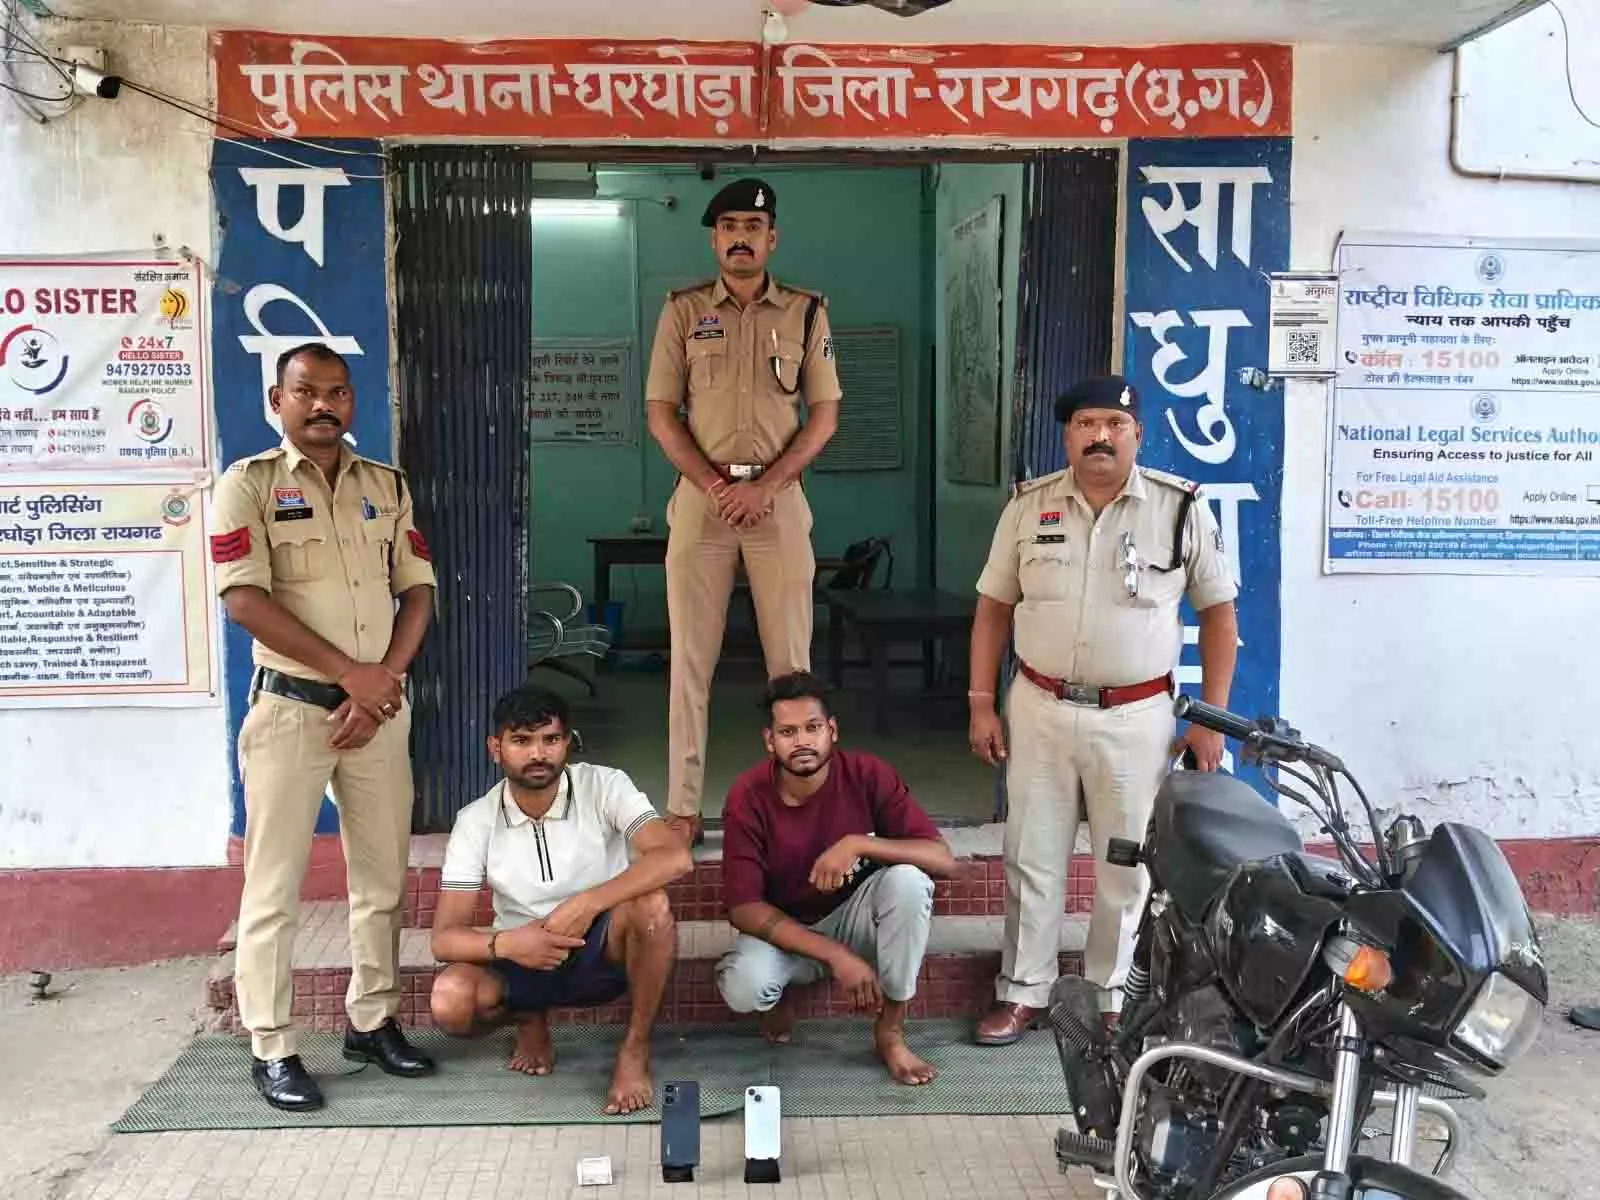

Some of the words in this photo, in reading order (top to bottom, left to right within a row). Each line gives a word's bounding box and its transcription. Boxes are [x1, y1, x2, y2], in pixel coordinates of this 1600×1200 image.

[240, 40, 409, 136] पुलिस
[35, 287, 137, 314] SISTER
[1343, 285, 1408, 310] राष्ट्रीय
[1414, 285, 1482, 309] विधिक
[1488, 287, 1528, 309] सेवा
[1405, 315, 1443, 328] न्याय
[1448, 316, 1475, 327] तक
[1481, 315, 1530, 329] आपकी
[1536, 316, 1571, 333] पहुँच
[121, 351, 150, 360] HELLO
[151, 351, 181, 360] SISTER
[1360, 350, 1403, 369] कॉल
[1421, 350, 1499, 369] 15100
[106, 363, 192, 376] 9479270533
[1337, 424, 1410, 442] National
[1416, 426, 1465, 446] Legal
[1471, 426, 1542, 444] Services
[1373, 448, 1433, 462] Ensuring
[1437, 449, 1485, 460] Access
[1489, 450, 1503, 461] to
[1553, 450, 1572, 461] for
[1575, 451, 1593, 461] All
[1356, 472, 1374, 483] For
[1375, 472, 1397, 483] Free
[1399, 472, 1426, 485] Legal
[1428, 473, 1445, 483] Aid
[1446, 473, 1499, 484] Assistance
[1421, 488, 1499, 511] 15100
[1523, 492, 1547, 503] Apply
[1550, 491, 1576, 501] Online
[26, 494, 103, 520] पुलिसिंग
[1355, 514, 1403, 526] Toll-Free
[1406, 515, 1451, 528] Helpline
[1454, 517, 1497, 527] Number
[49, 523, 96, 541] जिला
[70, 559, 113, 568] Strategic
[28, 585, 60, 593] Mobile
[63, 584, 71, 592] &
[73, 584, 126, 593] Meticulous
[16, 610, 75, 619] Accountable
[78, 610, 85, 618] &
[88, 609, 136, 619] Adaptable
[86, 633, 94, 642] &
[96, 633, 138, 642] Resilient
[43, 660, 78, 669] Trained
[81, 660, 88, 668] &
[91, 659, 147, 669] Transparent
